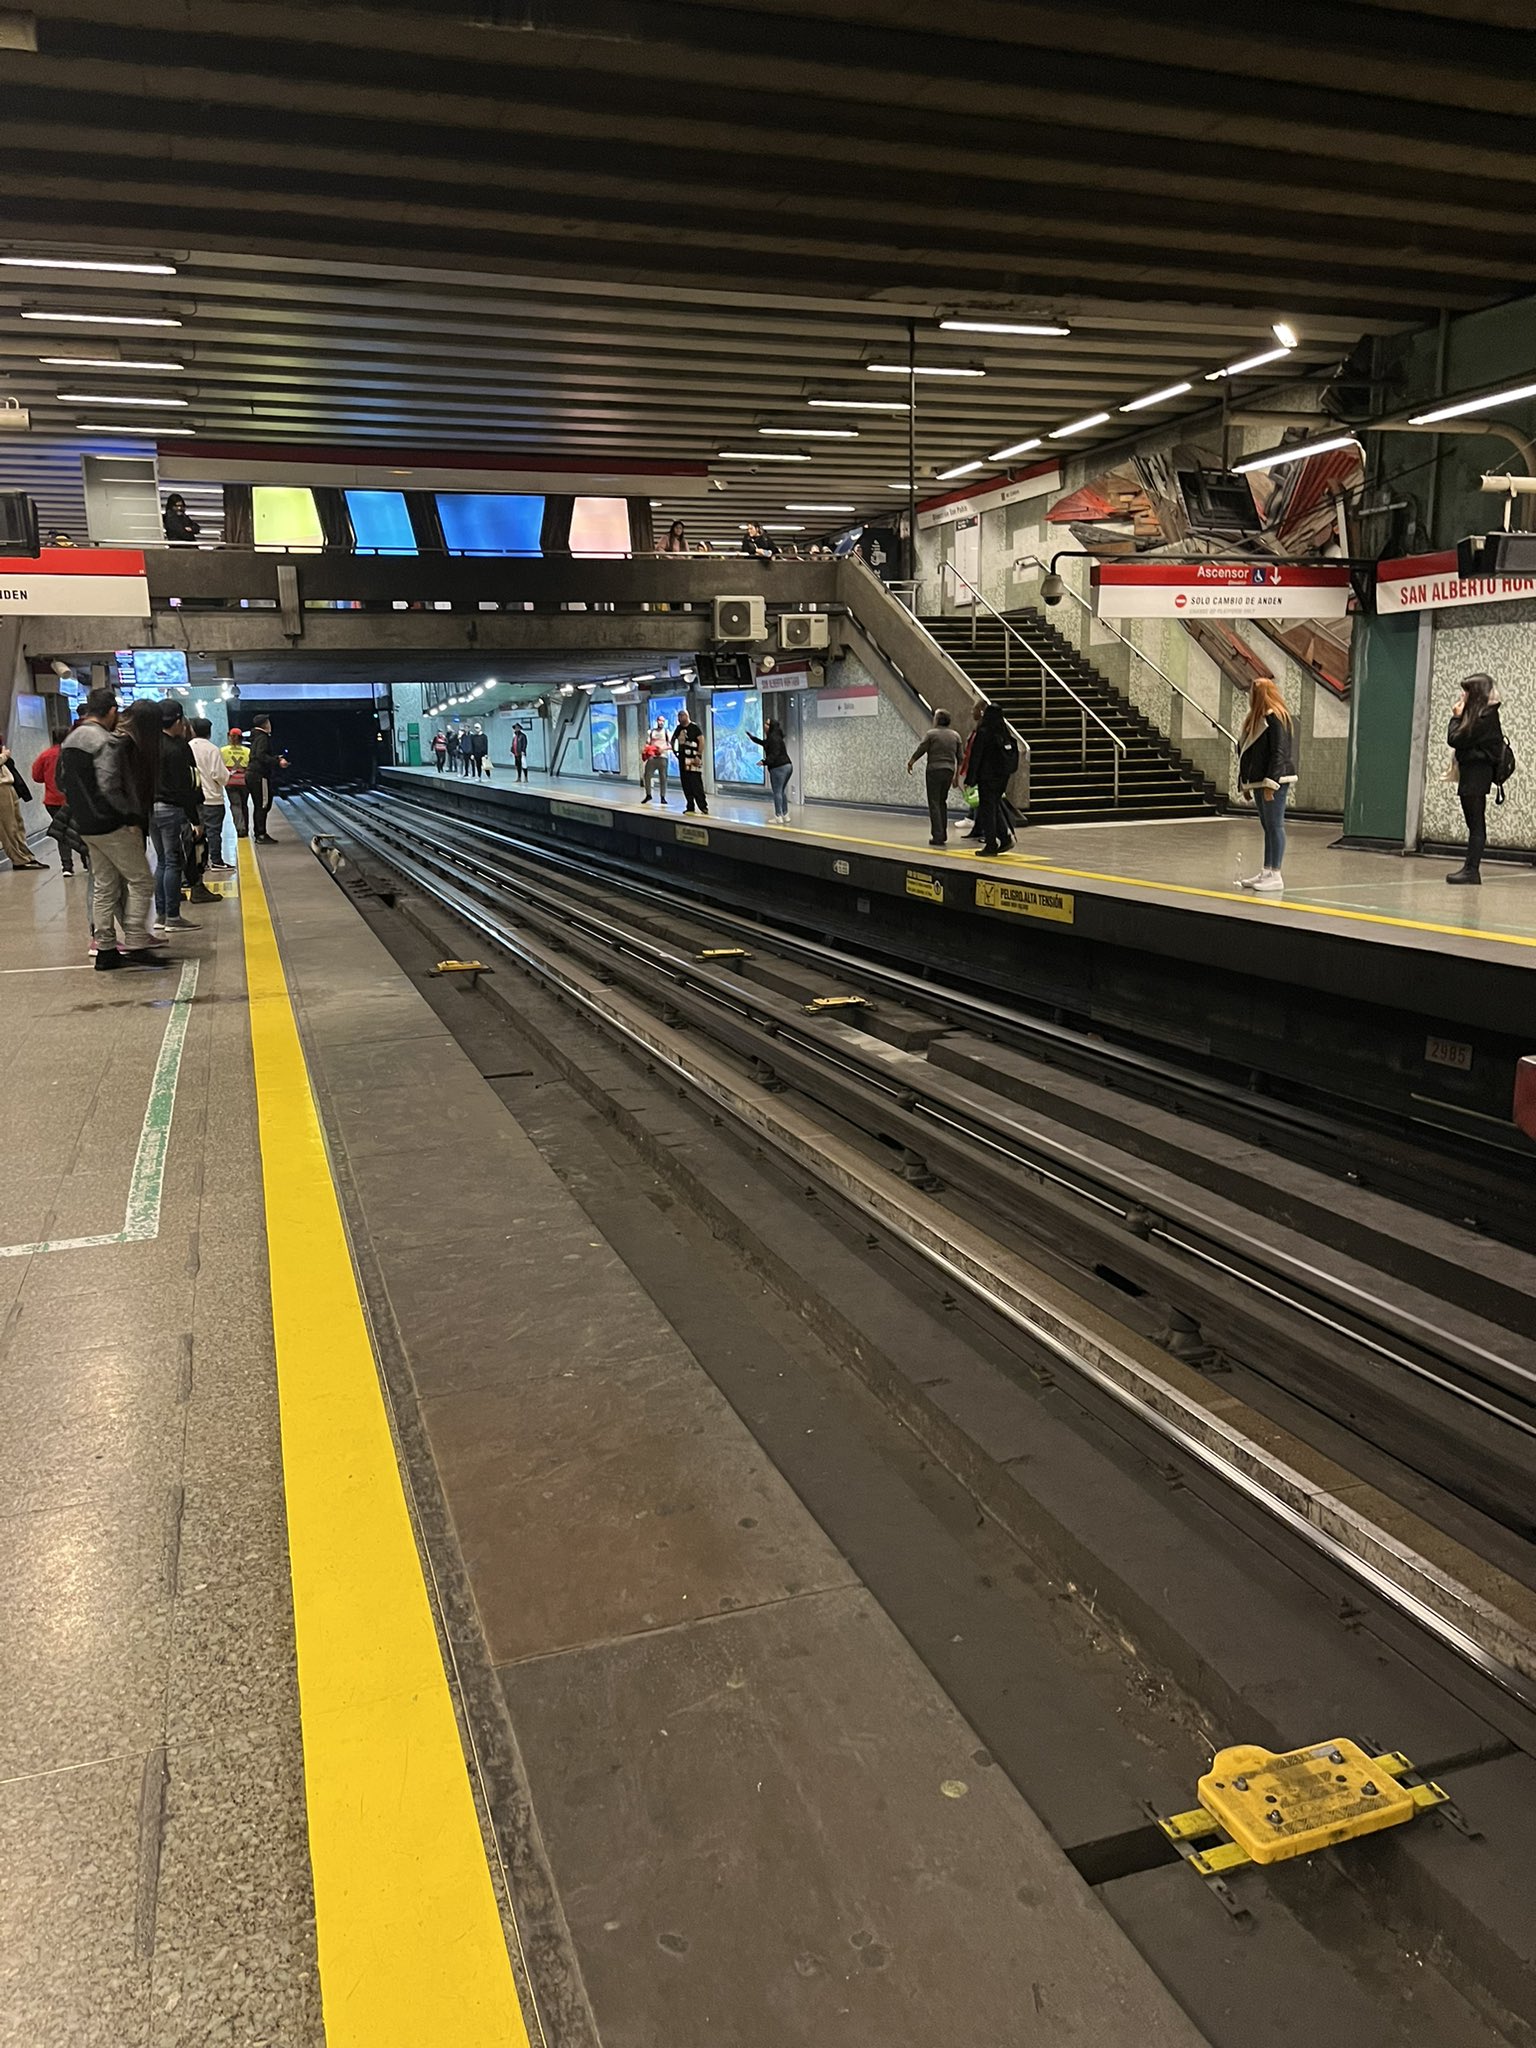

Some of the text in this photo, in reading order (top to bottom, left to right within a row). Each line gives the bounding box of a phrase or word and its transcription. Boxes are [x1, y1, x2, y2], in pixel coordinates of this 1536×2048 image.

[1197, 565, 1250, 579] Ascensor
[1191, 596, 1283, 606] SOLO CAMBIO DE ANDEN
[1400, 584, 1427, 606] SAN
